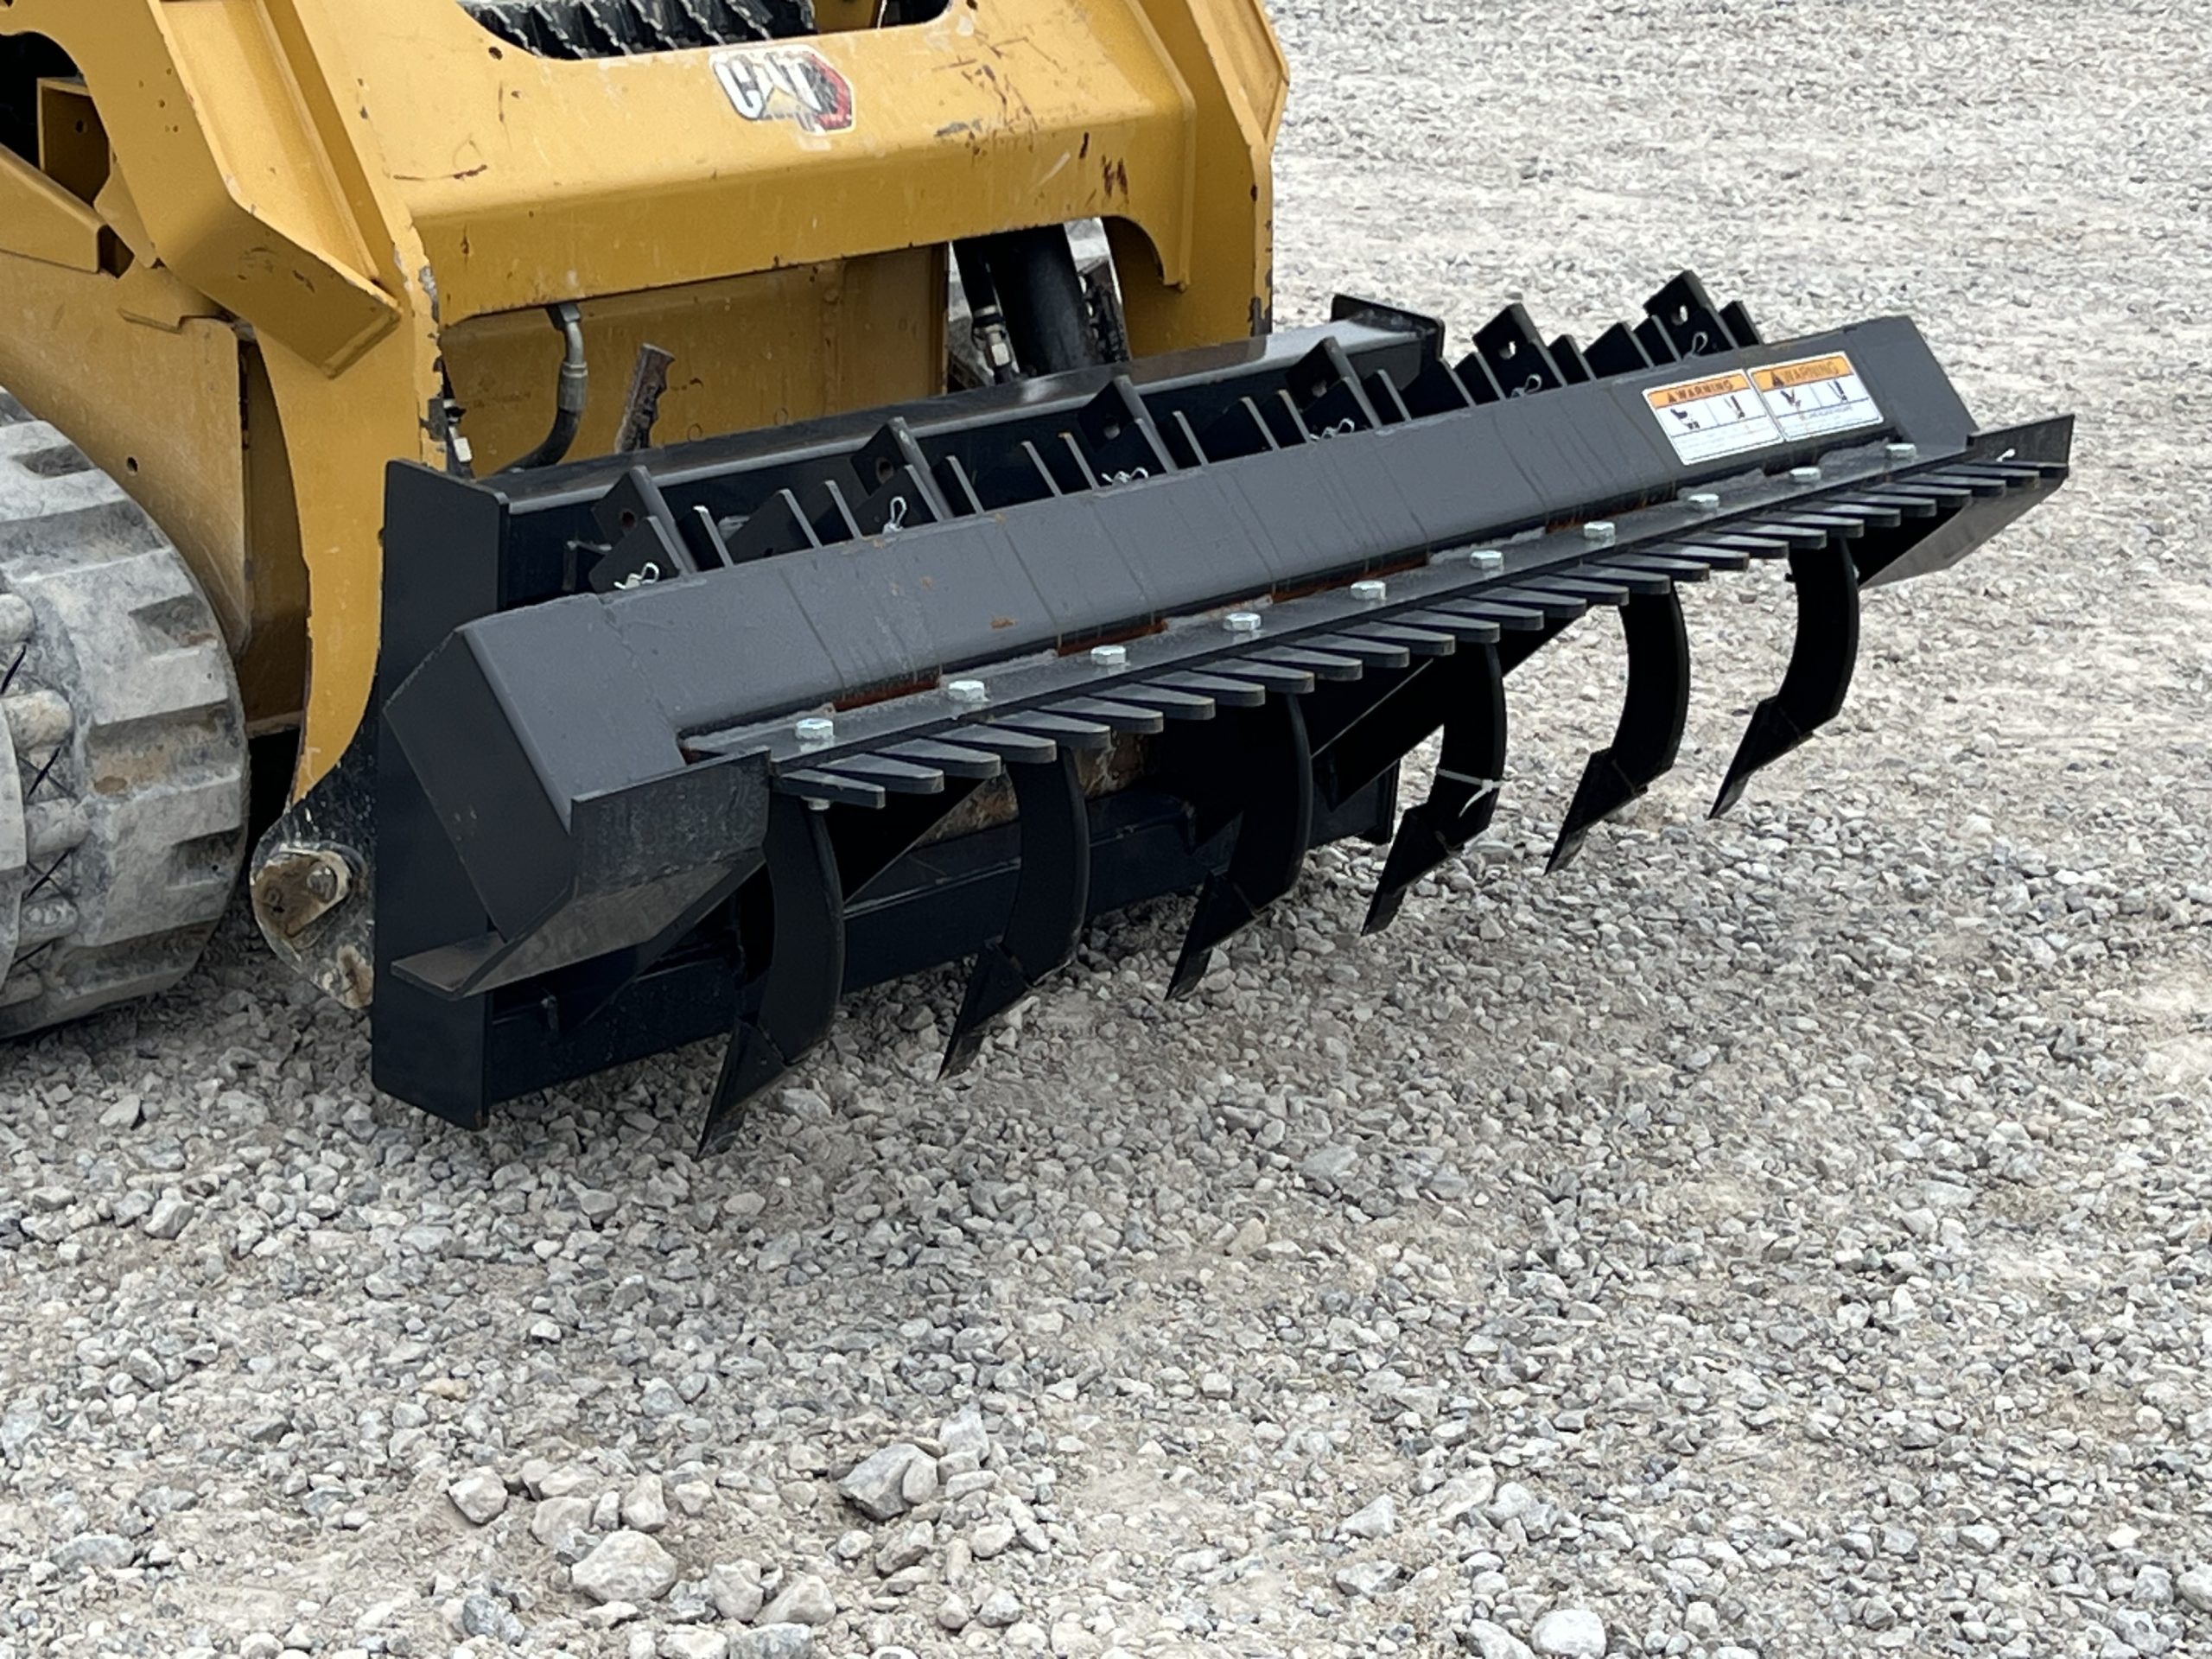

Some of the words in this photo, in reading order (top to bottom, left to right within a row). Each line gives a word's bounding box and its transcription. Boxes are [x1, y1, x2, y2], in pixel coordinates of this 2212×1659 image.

[713, 50, 823, 119] CAT
[1783, 361, 1840, 383] WARNING
[1676, 379, 1733, 400] WARNING
